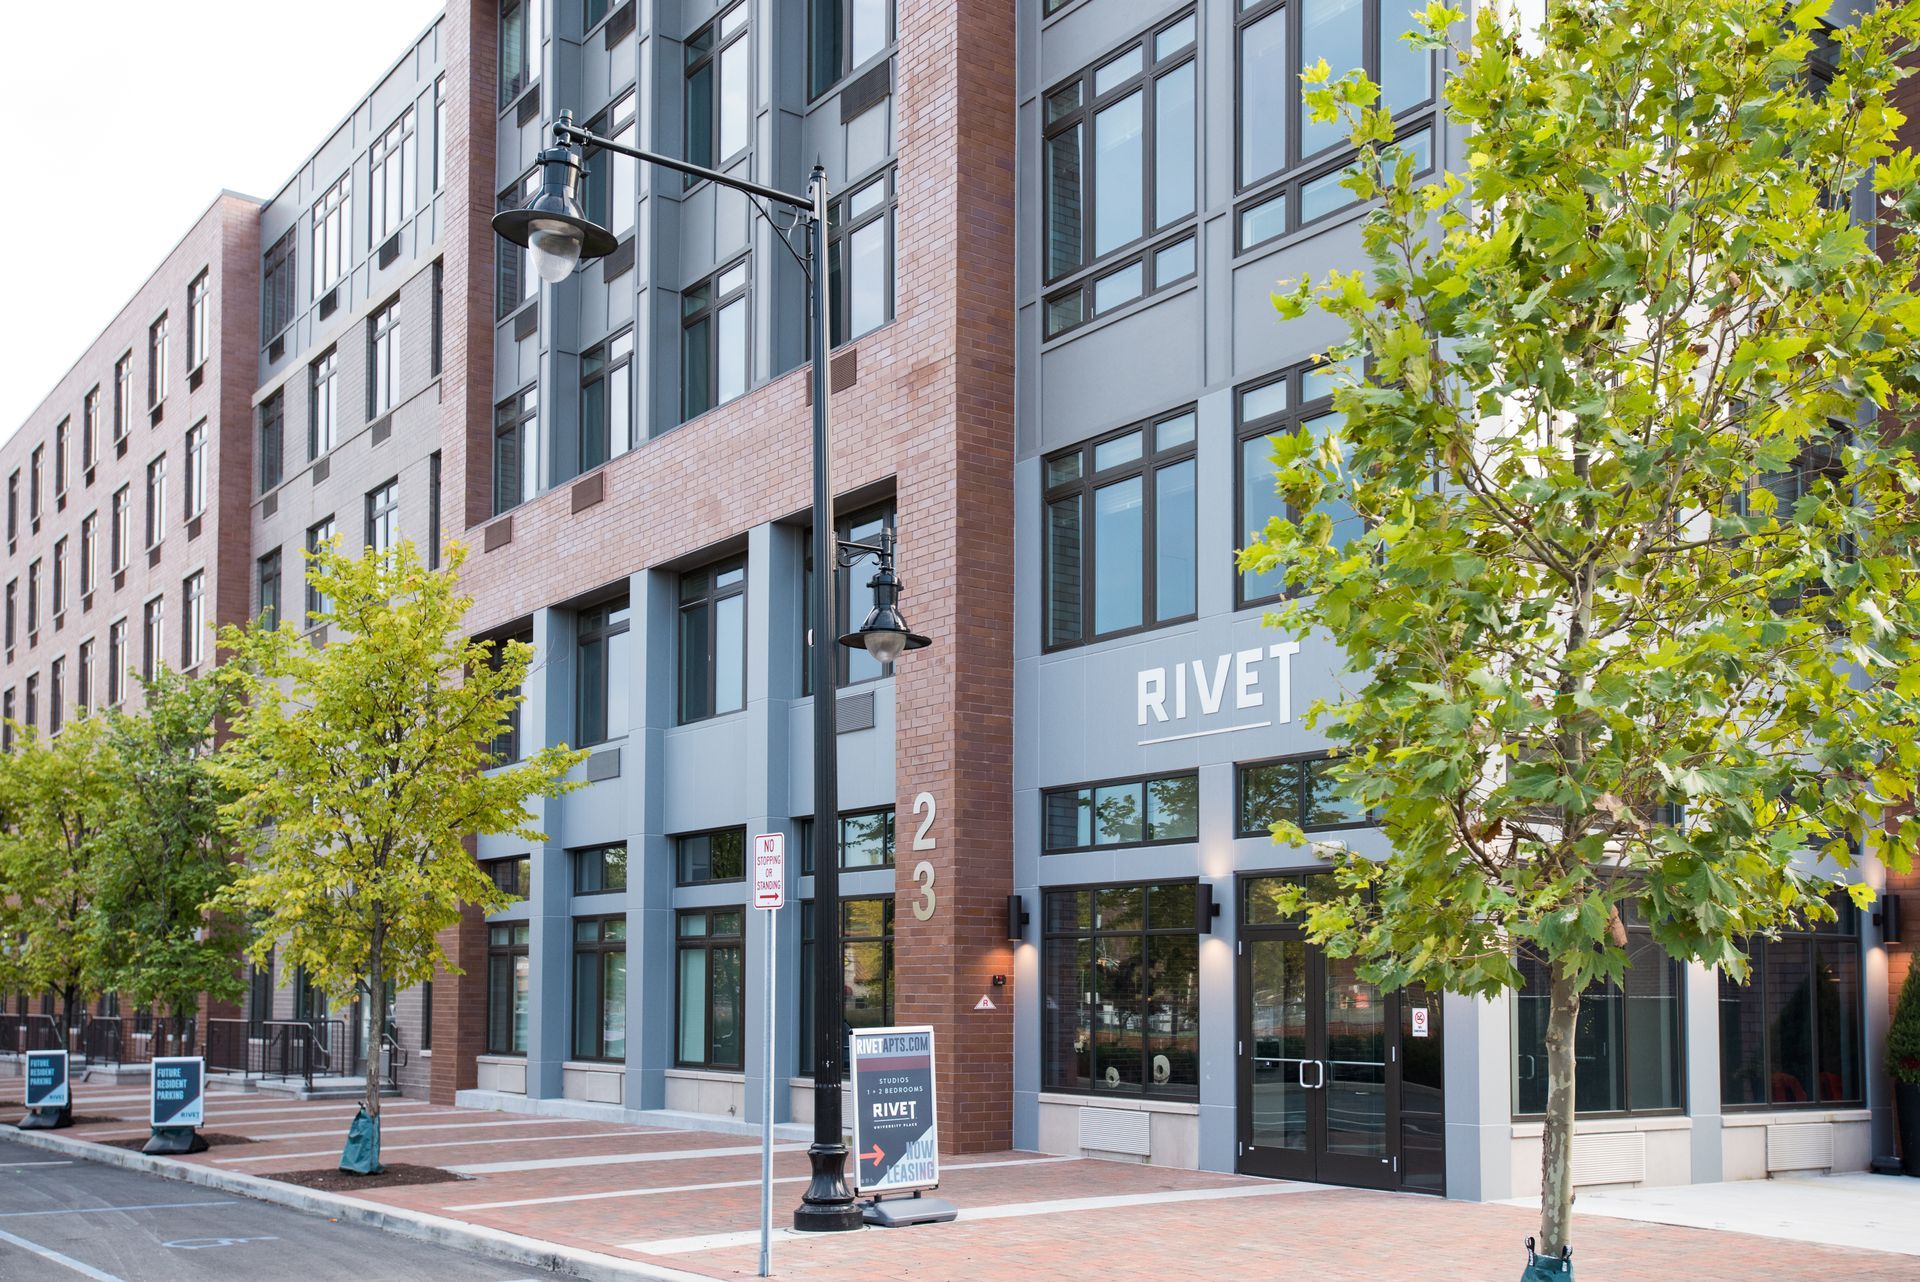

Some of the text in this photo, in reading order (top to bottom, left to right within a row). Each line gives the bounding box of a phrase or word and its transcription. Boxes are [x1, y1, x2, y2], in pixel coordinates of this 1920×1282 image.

[1137, 640, 1300, 726] RIVET
[764, 839, 774, 852] NO
[757, 855, 781, 866] STOPPING
[765, 868, 773, 878] OR
[757, 880, 781, 891] STANDING
[856, 1036, 929, 1055] RIVETAPTS.COM
[157, 1067, 181, 1078] FUTURE
[157, 1079, 187, 1089] RESIDENT
[879, 1076, 910, 1085] STUDIOS
[157, 1090, 184, 1100] PARKING
[885, 1086, 923, 1094] BEDROOMS
[872, 1100, 917, 1120] RIVET
[905, 1140, 934, 1160] NOW
[886, 1161, 935, 1183] LEASING
